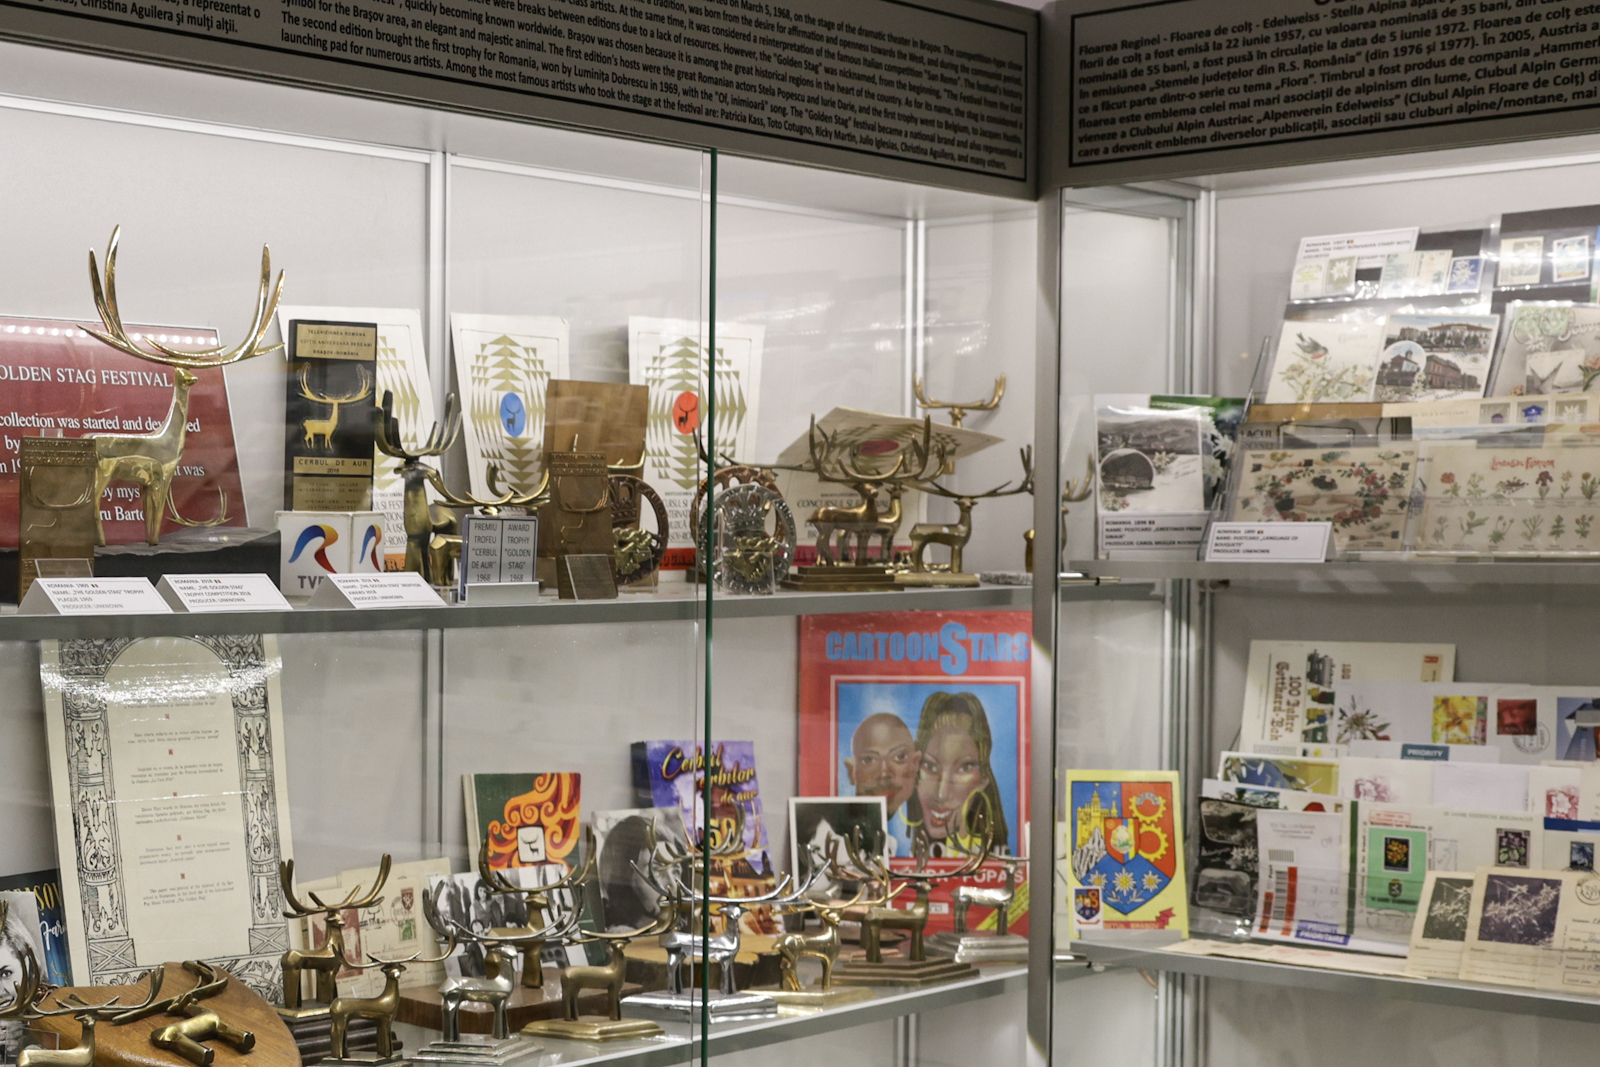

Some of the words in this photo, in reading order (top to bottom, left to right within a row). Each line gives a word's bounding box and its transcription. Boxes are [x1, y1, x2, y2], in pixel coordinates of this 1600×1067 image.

[130, 6, 173, 22] Aguilera
[440, 3, 483, 25] becoming
[485, 13, 515, 28] known
[517, 20, 565, 39] worldwide.
[282, 11, 300, 25] The
[303, 16, 337, 32] second
[340, 23, 373, 39] edition
[376, 28, 412, 47] brought
[1473, 16, 1521, 31] Floarea
[1539, 23, 1587, 38] Austria
[1079, 42, 1117, 55] Floarea
[1121, 35, 1160, 50] Reginei
[1170, 29, 1211, 43] Floarea
[1263, 12, 1320, 29] Edelweiss
[1243, 34, 1270, 47] iunie
[452, 44, 481, 61] trophy
[484, 48, 496, 61] for
[499, 52, 539, 71] Romania,
[541, 61, 560, 72] won
[562, 62, 572, 77] by
[1475, 64, 1516, 80] Clubul
[1521, 61, 1555, 77] Alpin
[282, 29, 328, 49] launching
[330, 40, 348, 53] pad
[350, 41, 363, 55] for
[366, 45, 411, 64] numerous
[414, 54, 443, 70] artists.
[446, 59, 477, 77] Among
[479, 64, 493, 77] the
[495, 70, 516, 82] most
[519, 73, 549, 88] famous
[551, 79, 576, 92] artists
[578, 84, 595, 96] who
[721, 109, 746, 123] Patricia
[767, 117, 782, 129] Toto
[784, 120, 813, 136] Cotugno,
[698, 72, 734, 89] Romanian
[736, 81, 756, 92] actors
[1112, 140, 1152, 154] devenit
[1155, 134, 1207, 149] emblema
[1210, 127, 1267, 144] diverselor
[1409, 102, 1453, 120] cluburi
[56, 367, 97, 384] STAG
[102, 369, 173, 388] FESTIVAL
[58, 418, 80, 429] was
[83, 416, 120, 430] started
[123, 418, 142, 431] and
[474, 523, 497, 531] PREMIU
[507, 536, 530, 544] TROPHY
[472, 561, 479, 569] DE
[1406, 749, 1443, 758] PRIORITY
